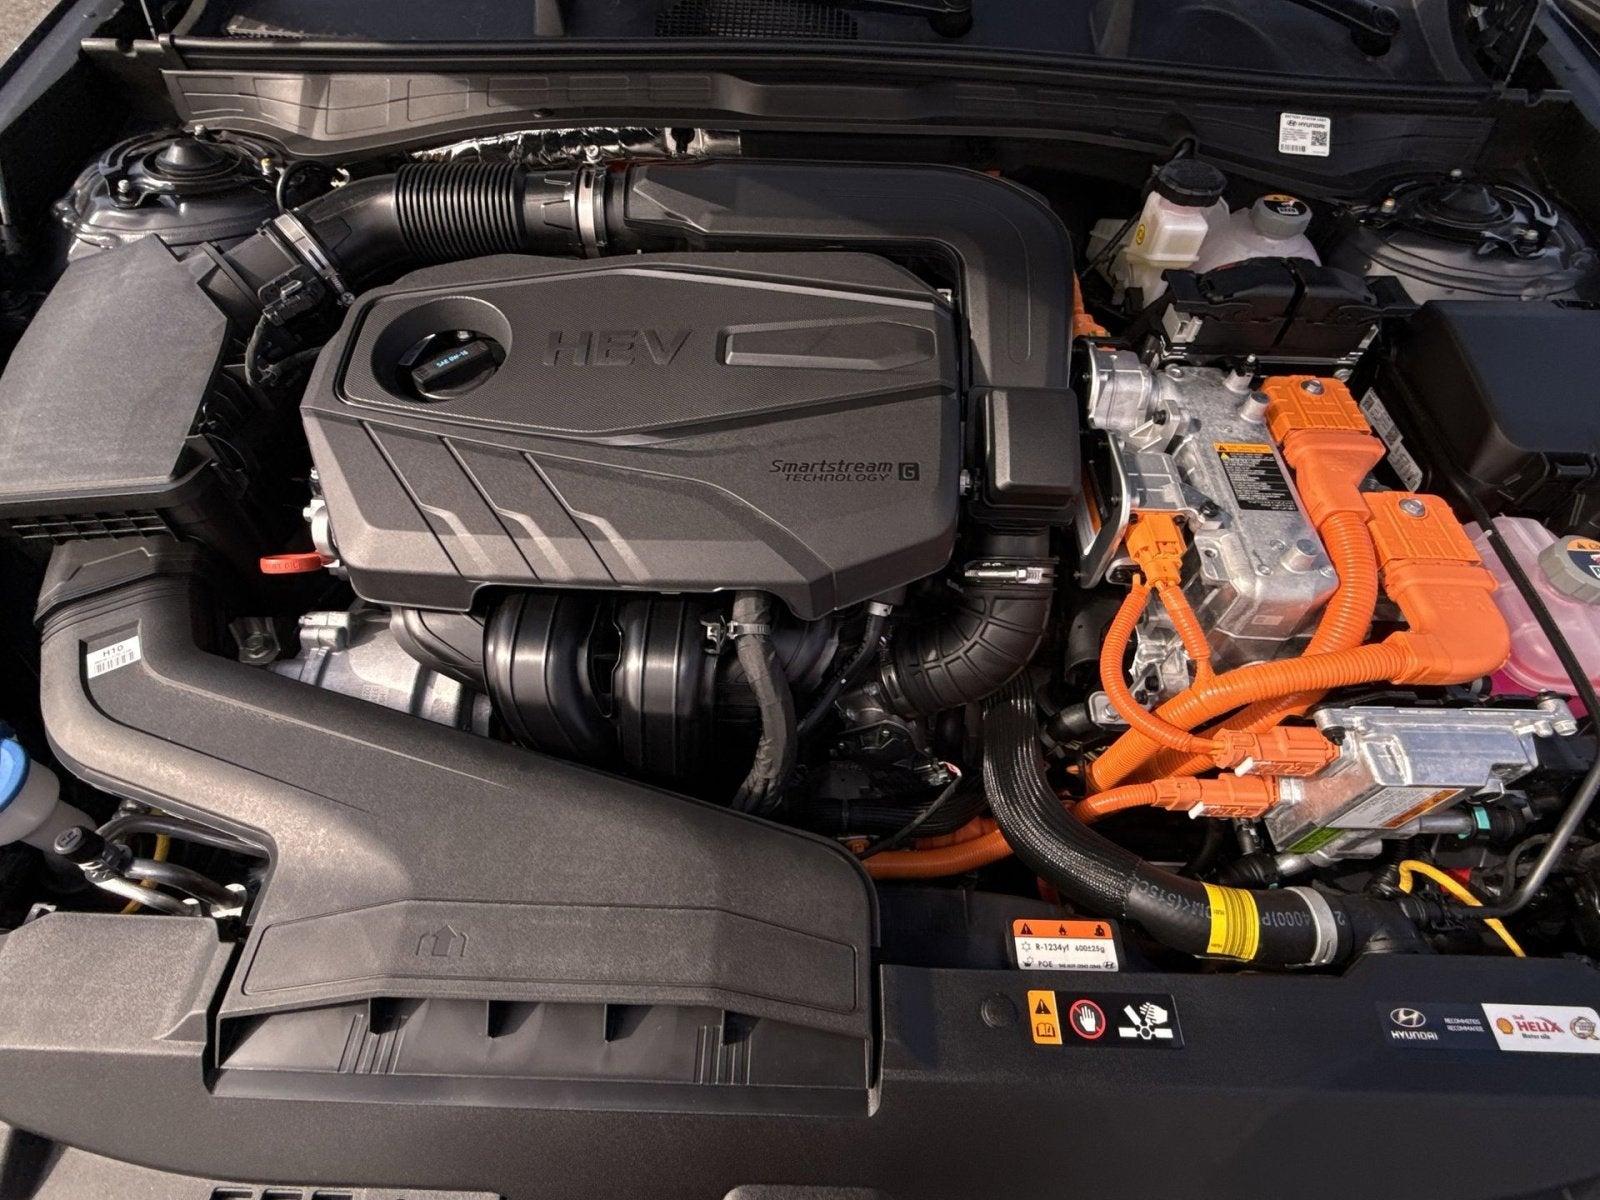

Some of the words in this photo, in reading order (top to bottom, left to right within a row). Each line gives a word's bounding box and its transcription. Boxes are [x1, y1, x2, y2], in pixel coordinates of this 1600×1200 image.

[543, 329, 694, 366] HEV
[769, 459, 893, 473] Smartstream
[901, 463, 918, 480] G
[784, 473, 890, 482] TECHNOLOGY
[102, 644, 124, 657] H10
[1035, 943, 1070, 953] R-1234yf
[1038, 960, 1053, 968] POE
[1516, 1019, 1565, 1034] HELIX
[1390, 1030, 1438, 1040] HYUNDAI
